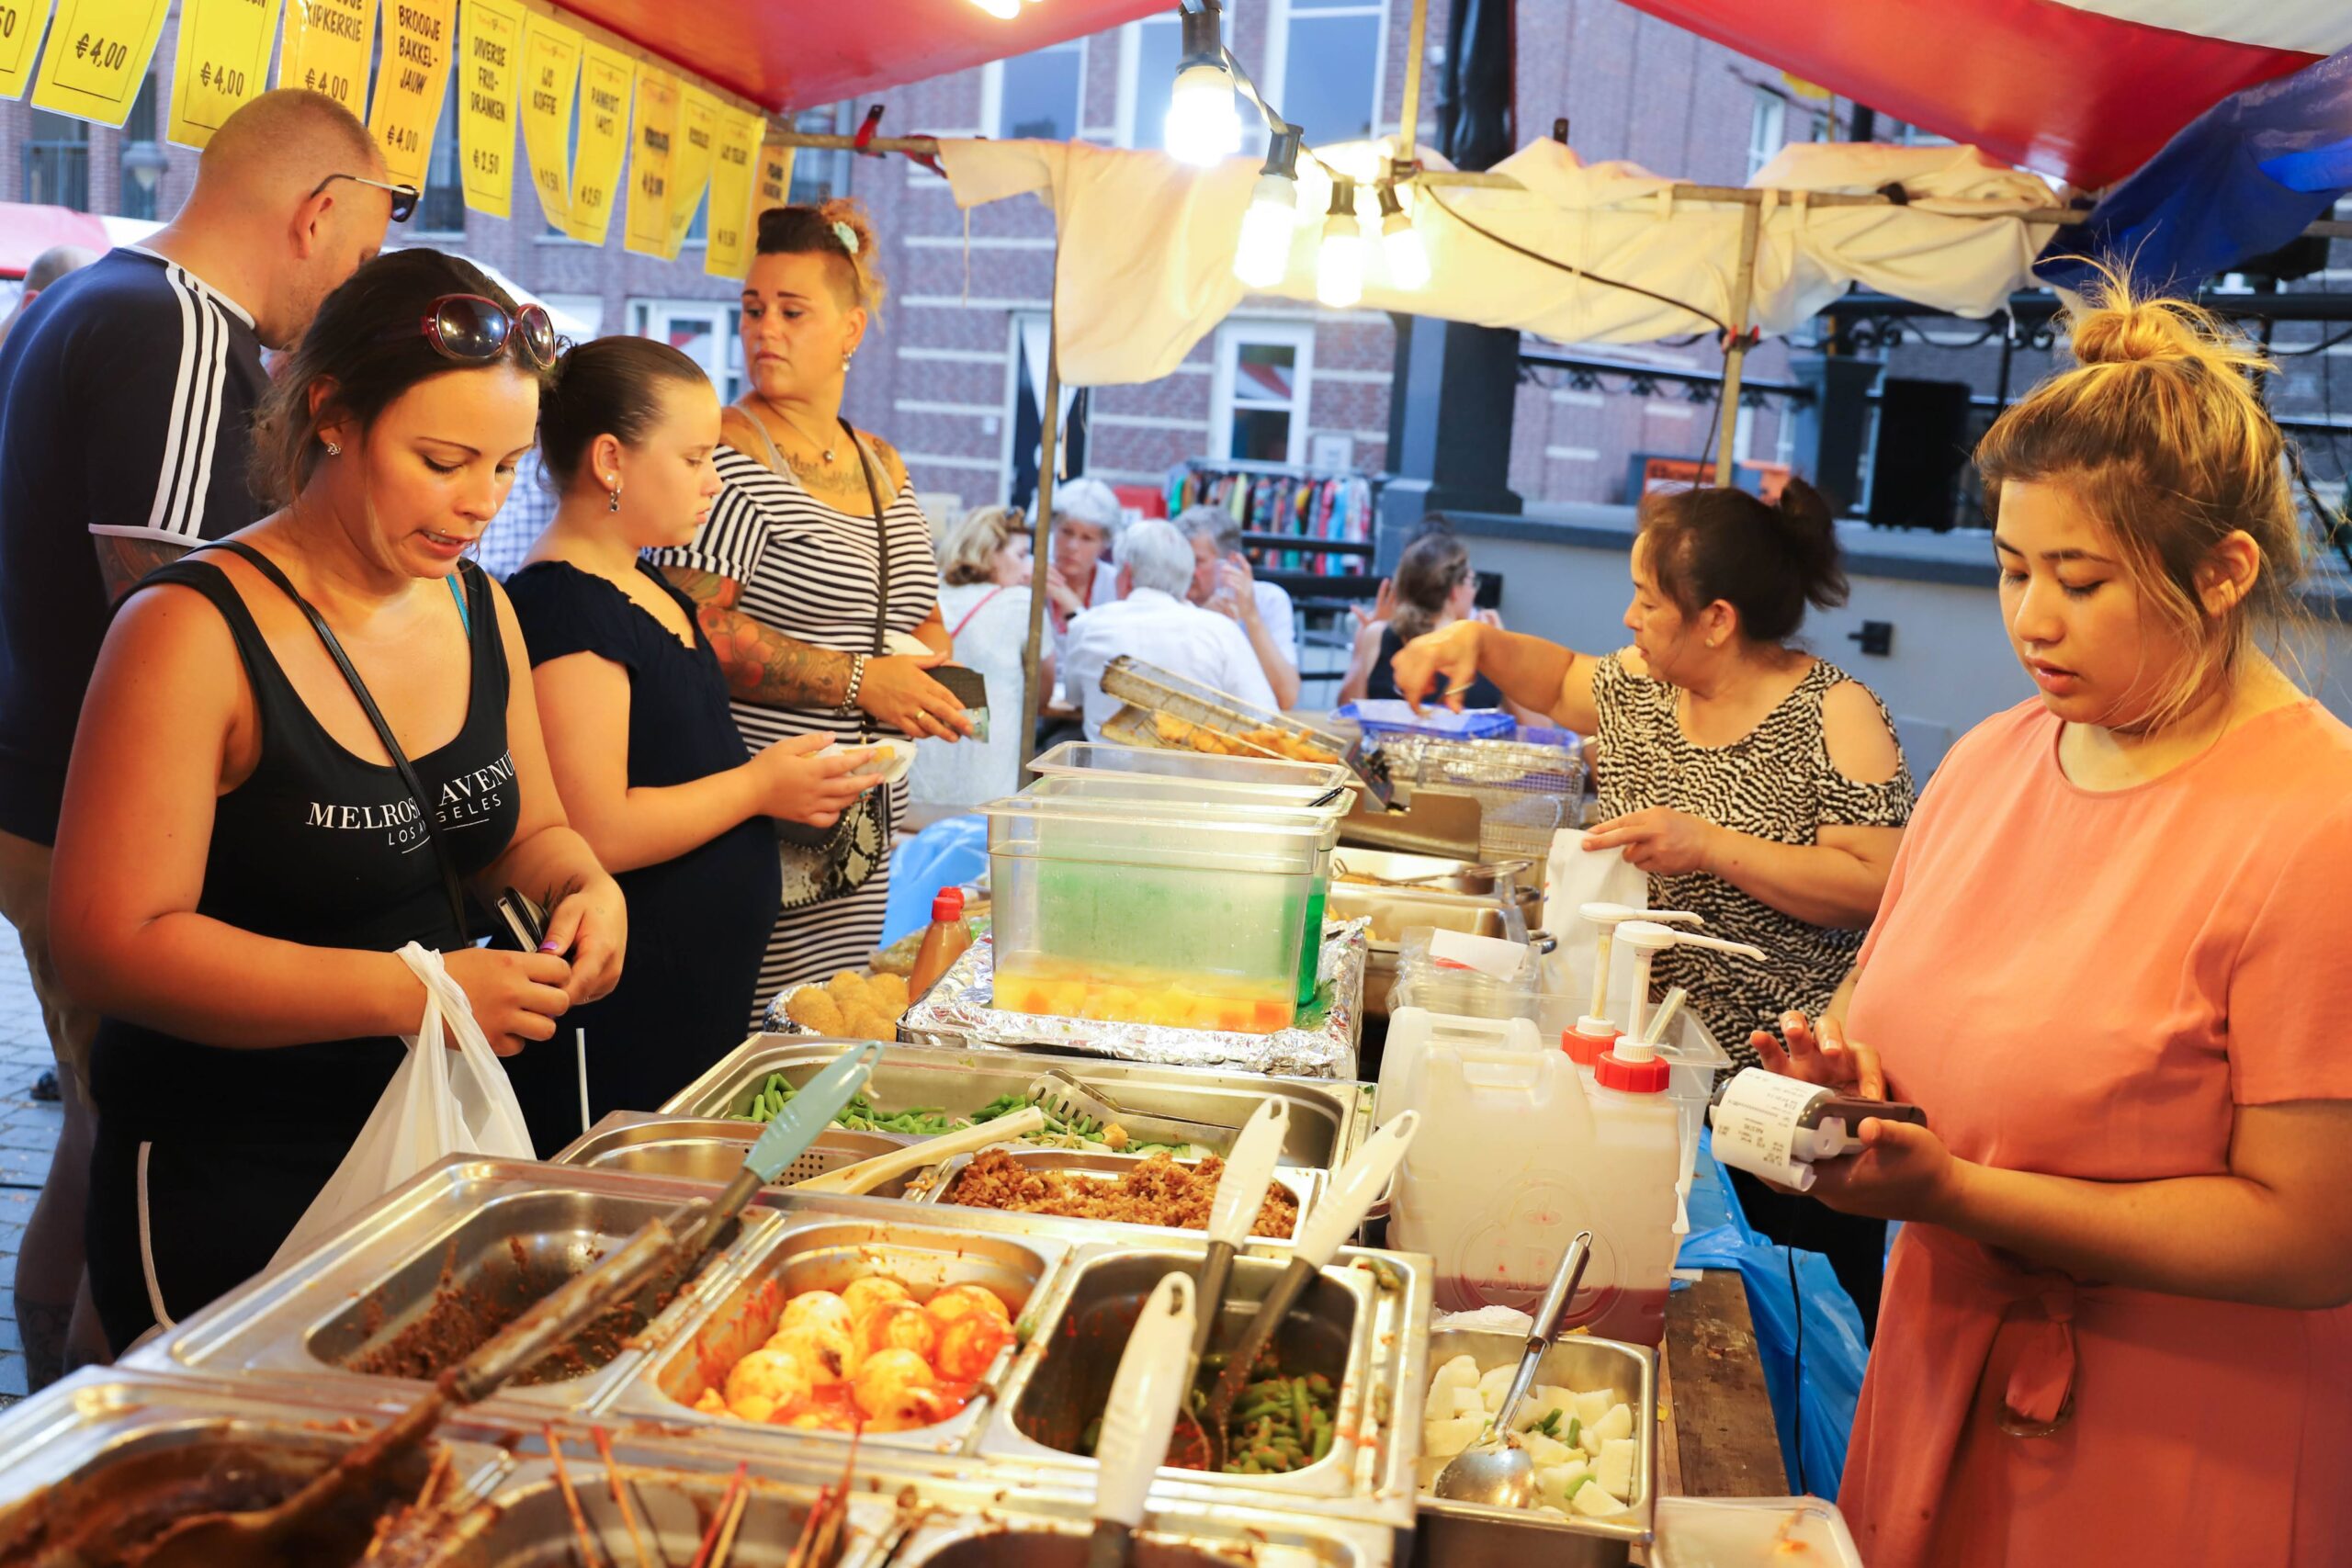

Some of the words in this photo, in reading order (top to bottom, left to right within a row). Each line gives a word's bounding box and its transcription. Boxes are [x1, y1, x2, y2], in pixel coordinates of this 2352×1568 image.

[305, 1, 362, 42] KIPKERRIE
[399, 5, 441, 41] BROODJE
[399, 36, 438, 68] BAKKEL-
[474, 36, 506, 68] DIVERSE
[400, 67, 427, 96] JAUW
[479, 66, 499, 92] FRIS-
[471, 91, 505, 123] DRANKEN
[533, 89, 557, 116] KOFFIE
[304, 795, 421, 829] MELROS
[438, 749, 515, 807] AVENU
[389, 826, 415, 846] LOS
